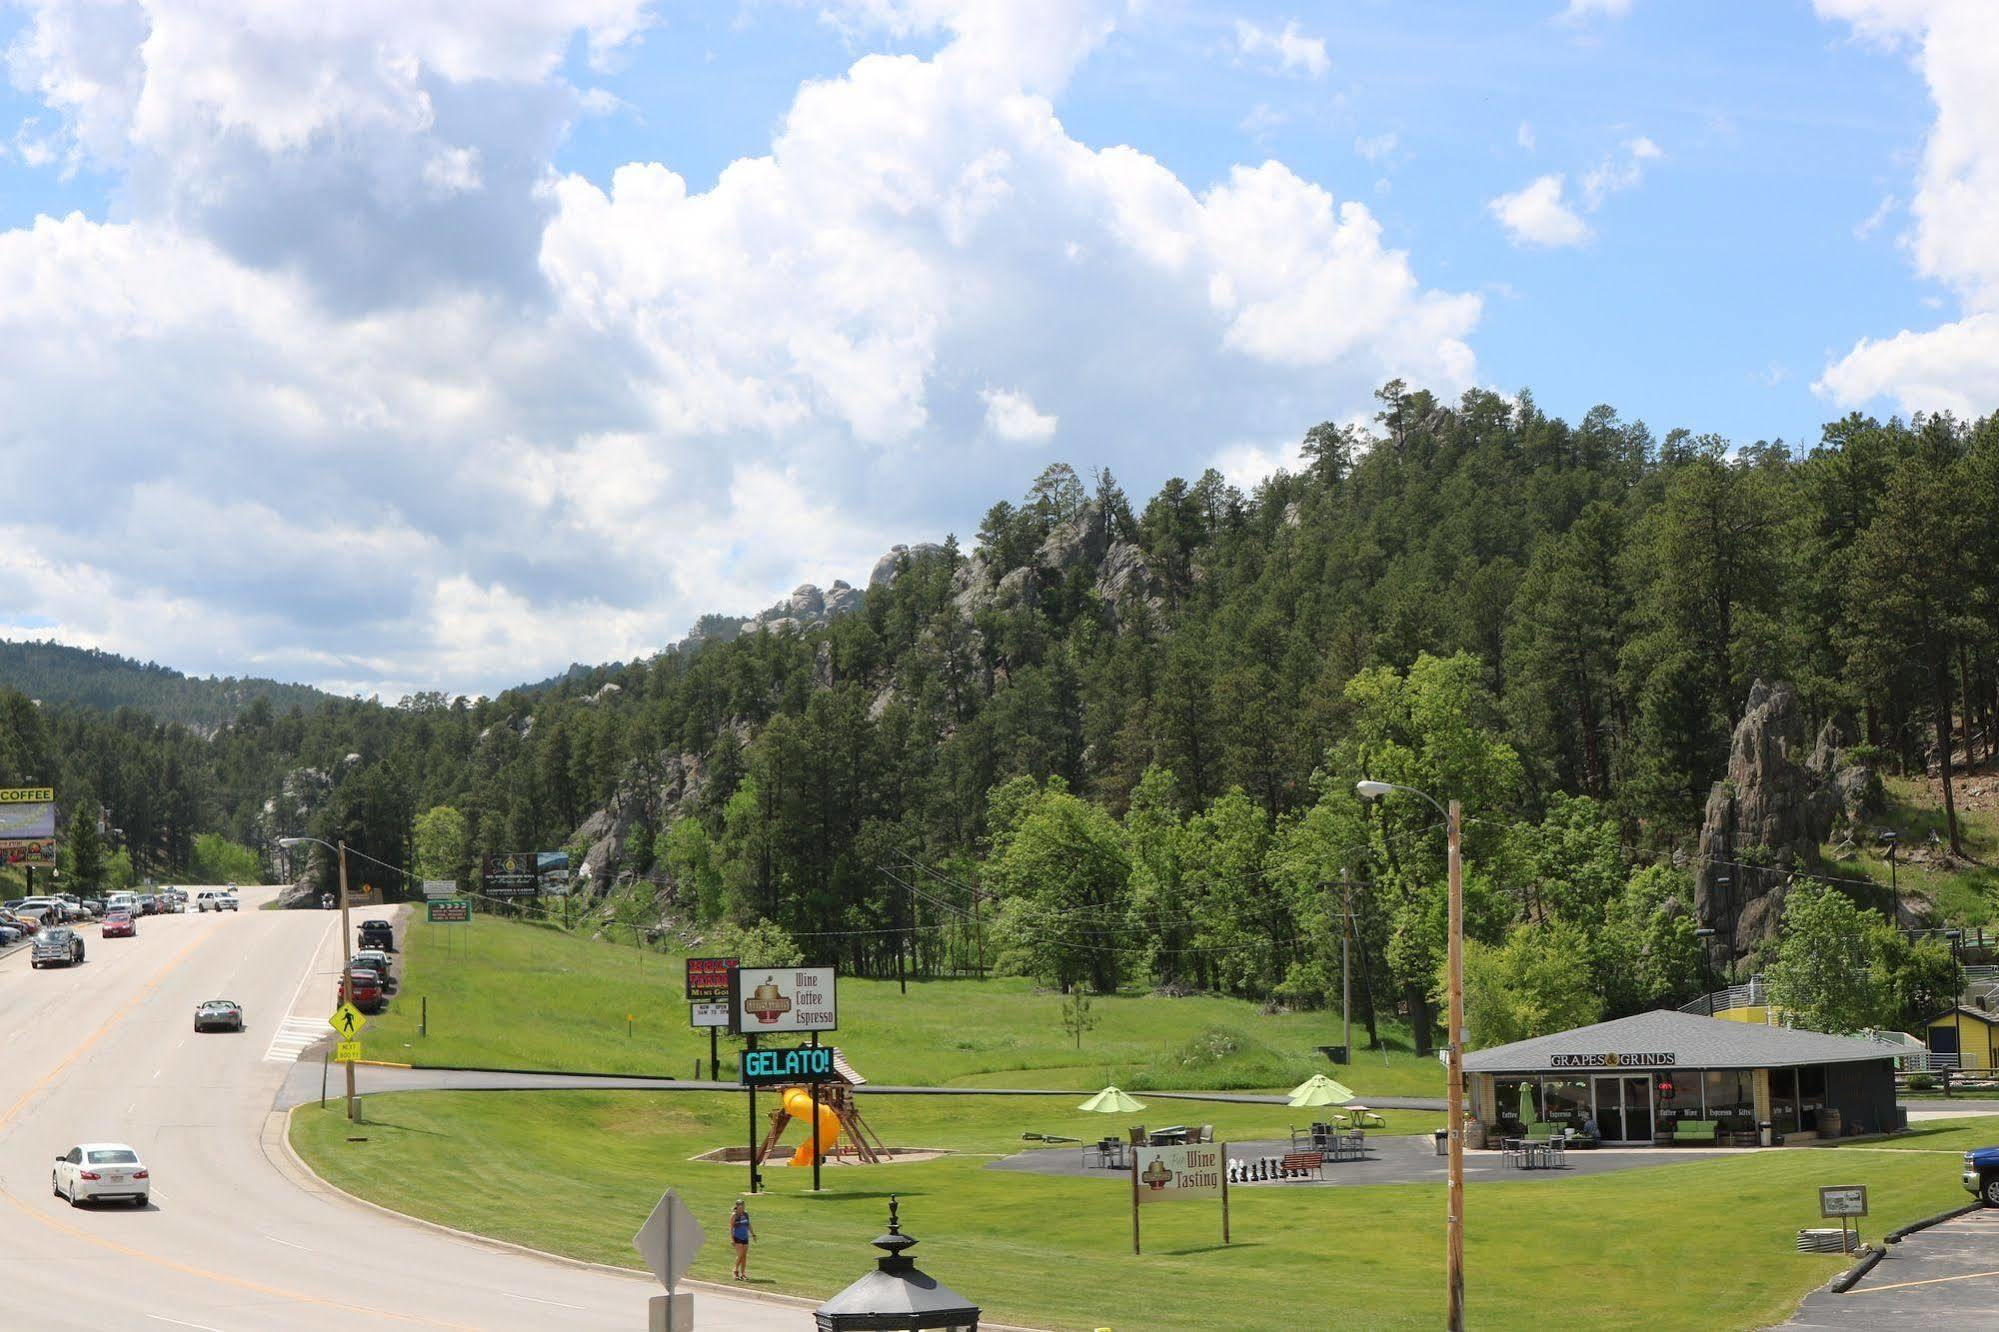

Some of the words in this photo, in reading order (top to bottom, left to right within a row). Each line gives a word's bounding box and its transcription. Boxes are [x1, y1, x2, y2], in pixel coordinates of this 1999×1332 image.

[0, 790, 50, 800] COFFEE
[796, 972, 817, 987] Wine
[796, 991, 823, 1005] Coffee
[796, 1010, 834, 1025] Espresso
[746, 1050, 830, 1076] GELATO!
[1551, 1054, 1605, 1066] GRAPES
[1620, 1053, 1675, 1065] GRINDS
[1186, 1150, 1216, 1168] Wine
[1175, 1170, 1218, 1189] Tasting
